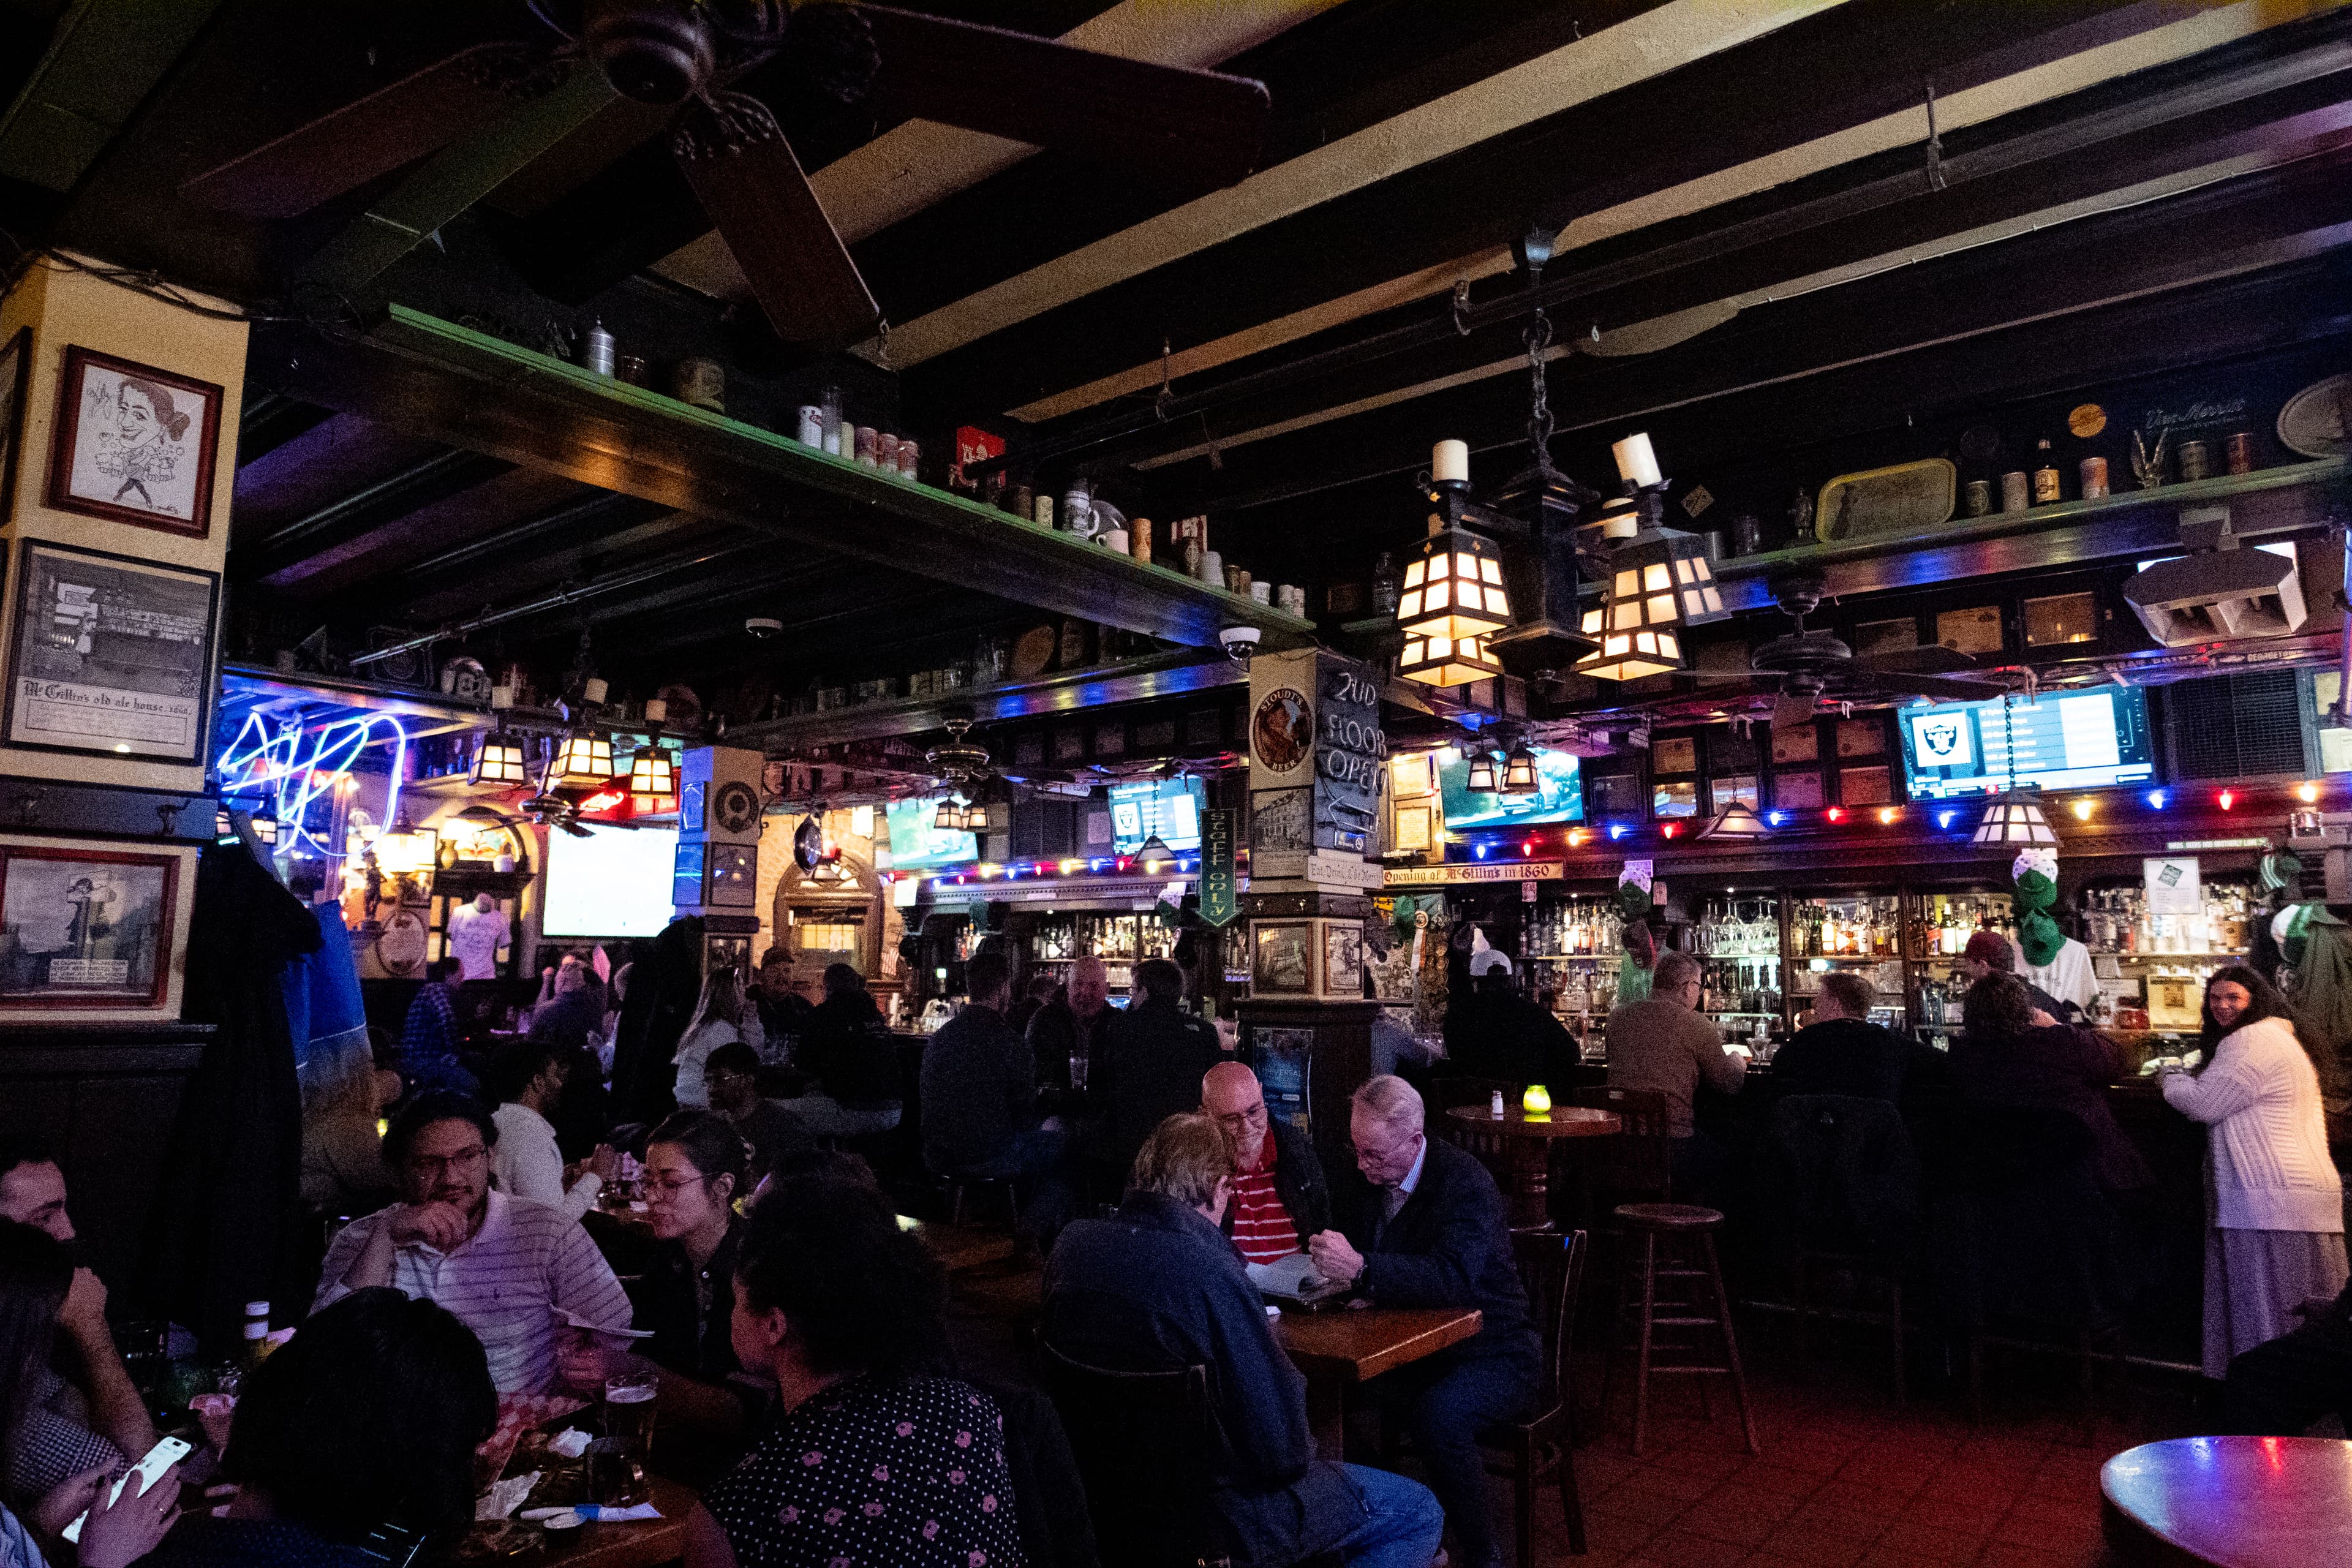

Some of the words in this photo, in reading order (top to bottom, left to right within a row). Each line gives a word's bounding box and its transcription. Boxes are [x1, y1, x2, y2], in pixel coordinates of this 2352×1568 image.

[93, 693, 111, 706] old
[115, 696, 130, 709] ale
[1260, 690, 1303, 712] STOUDT'S
[1329, 714, 1387, 757] FLOOR
[1272, 759, 1297, 772] BEER
[1328, 749, 1388, 793] OPEN
[1384, 870, 1427, 882] Opening
[1430, 869, 1441, 881] of
[1504, 867, 1517, 878] in
[1520, 864, 1550, 877] 1860
